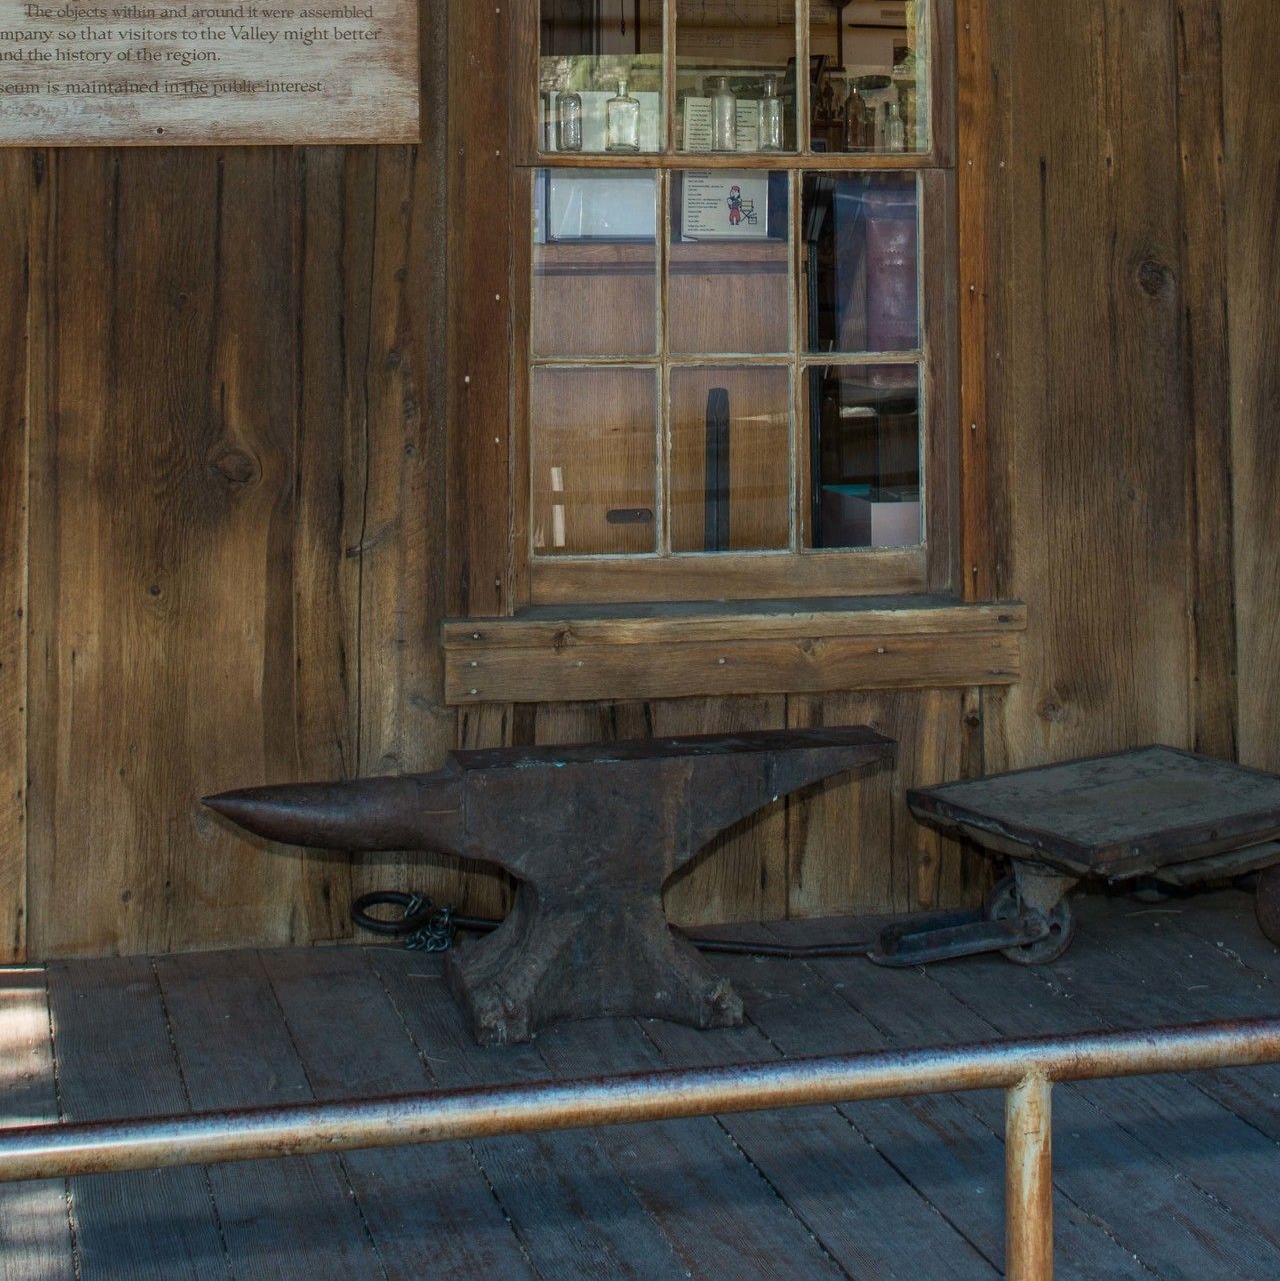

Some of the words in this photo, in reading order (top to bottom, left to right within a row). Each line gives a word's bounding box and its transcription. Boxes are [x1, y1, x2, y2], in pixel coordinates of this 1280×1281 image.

[24, 3, 53, 18] The
[57, 4, 108, 21] objects
[112, 5, 155, 18] within
[160, 5, 187, 18] and
[191, 6, 244, 19] around
[248, 6, 259, 18] it
[262, 9, 295, 19] were
[299, 6, 373, 19] assembled
[58, 31, 76, 40] so
[81, 27, 113, 40] that
[118, 27, 178, 40] visitors
[182, 30, 198, 40] to
[201, 27, 226, 40] the
[230, 25, 279, 44] Valley
[284, 27, 329, 46] might
[334, 27, 380, 40] better
[27, 49, 53, 61] the
[56, 49, 112, 64] history
[117, 48, 134, 61] of
[136, 49, 162, 61] the
[166, 49, 221, 66] region.
[46, 81, 60, 94] is
[65, 81, 159, 94] maintained
[164, 81, 180, 93] in
[182, 80, 208, 93] the
[212, 80, 260, 96] public
